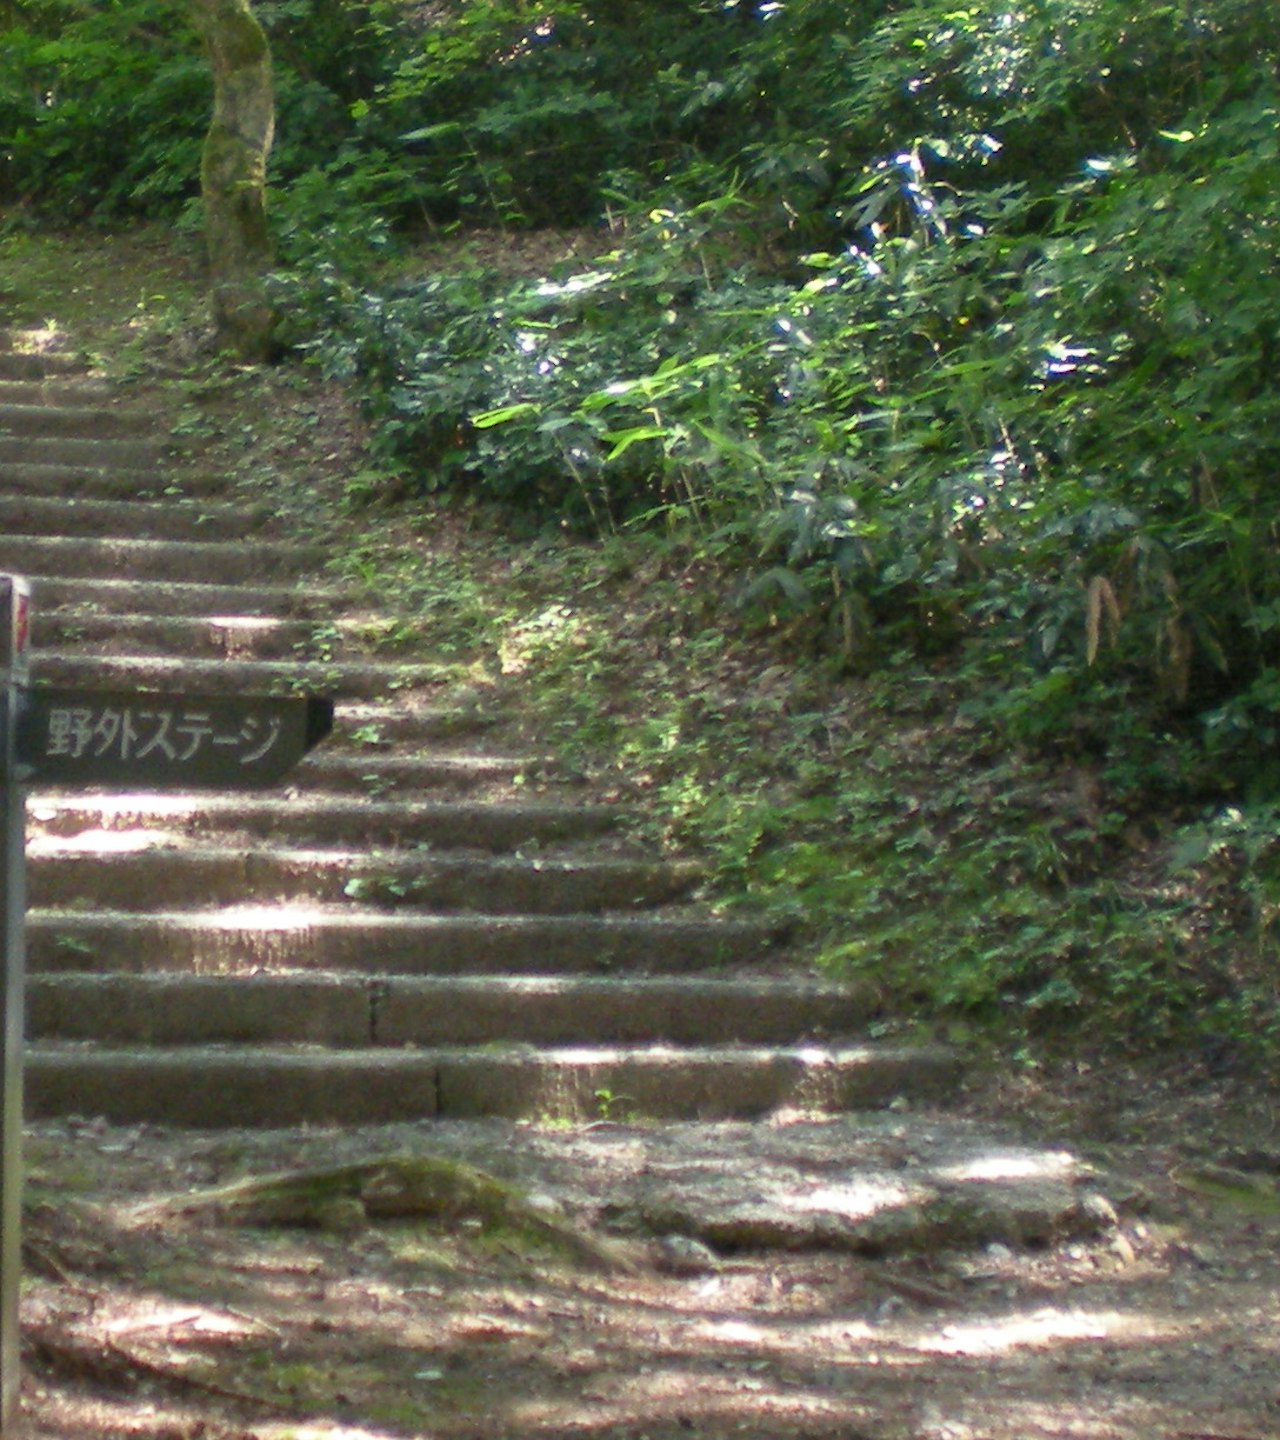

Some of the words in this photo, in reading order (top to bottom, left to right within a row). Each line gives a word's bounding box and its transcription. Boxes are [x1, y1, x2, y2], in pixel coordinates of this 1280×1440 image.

[46, 708, 281, 764] 野外ステージ
